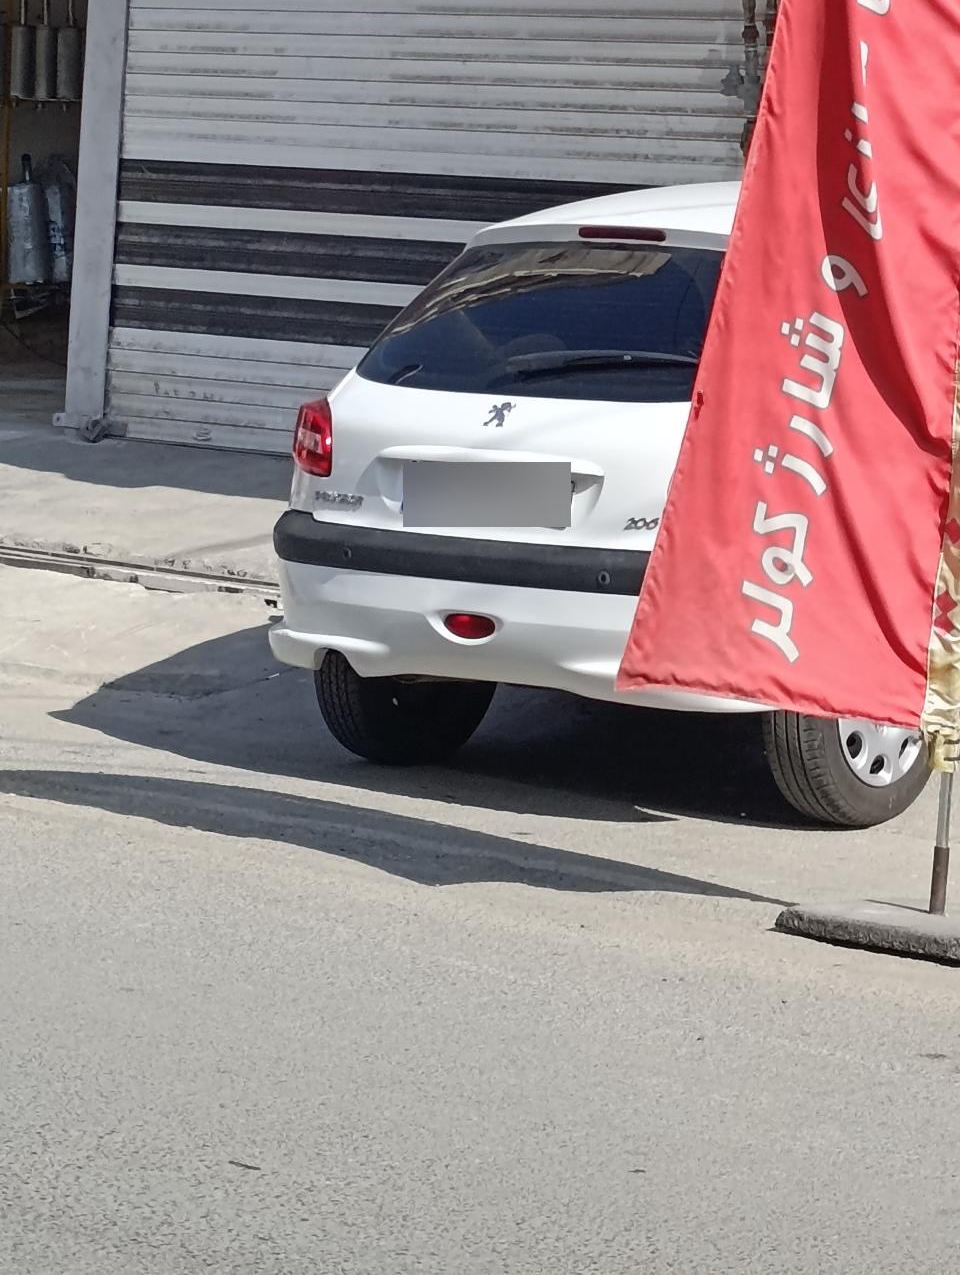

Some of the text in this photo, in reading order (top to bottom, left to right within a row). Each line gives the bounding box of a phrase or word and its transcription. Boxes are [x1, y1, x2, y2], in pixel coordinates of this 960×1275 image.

[820, 254, 869, 298] و
[753, 310, 845, 496] شارژ
[623, 517, 660, 531] 206
[741, 499, 814, 664] کولر
